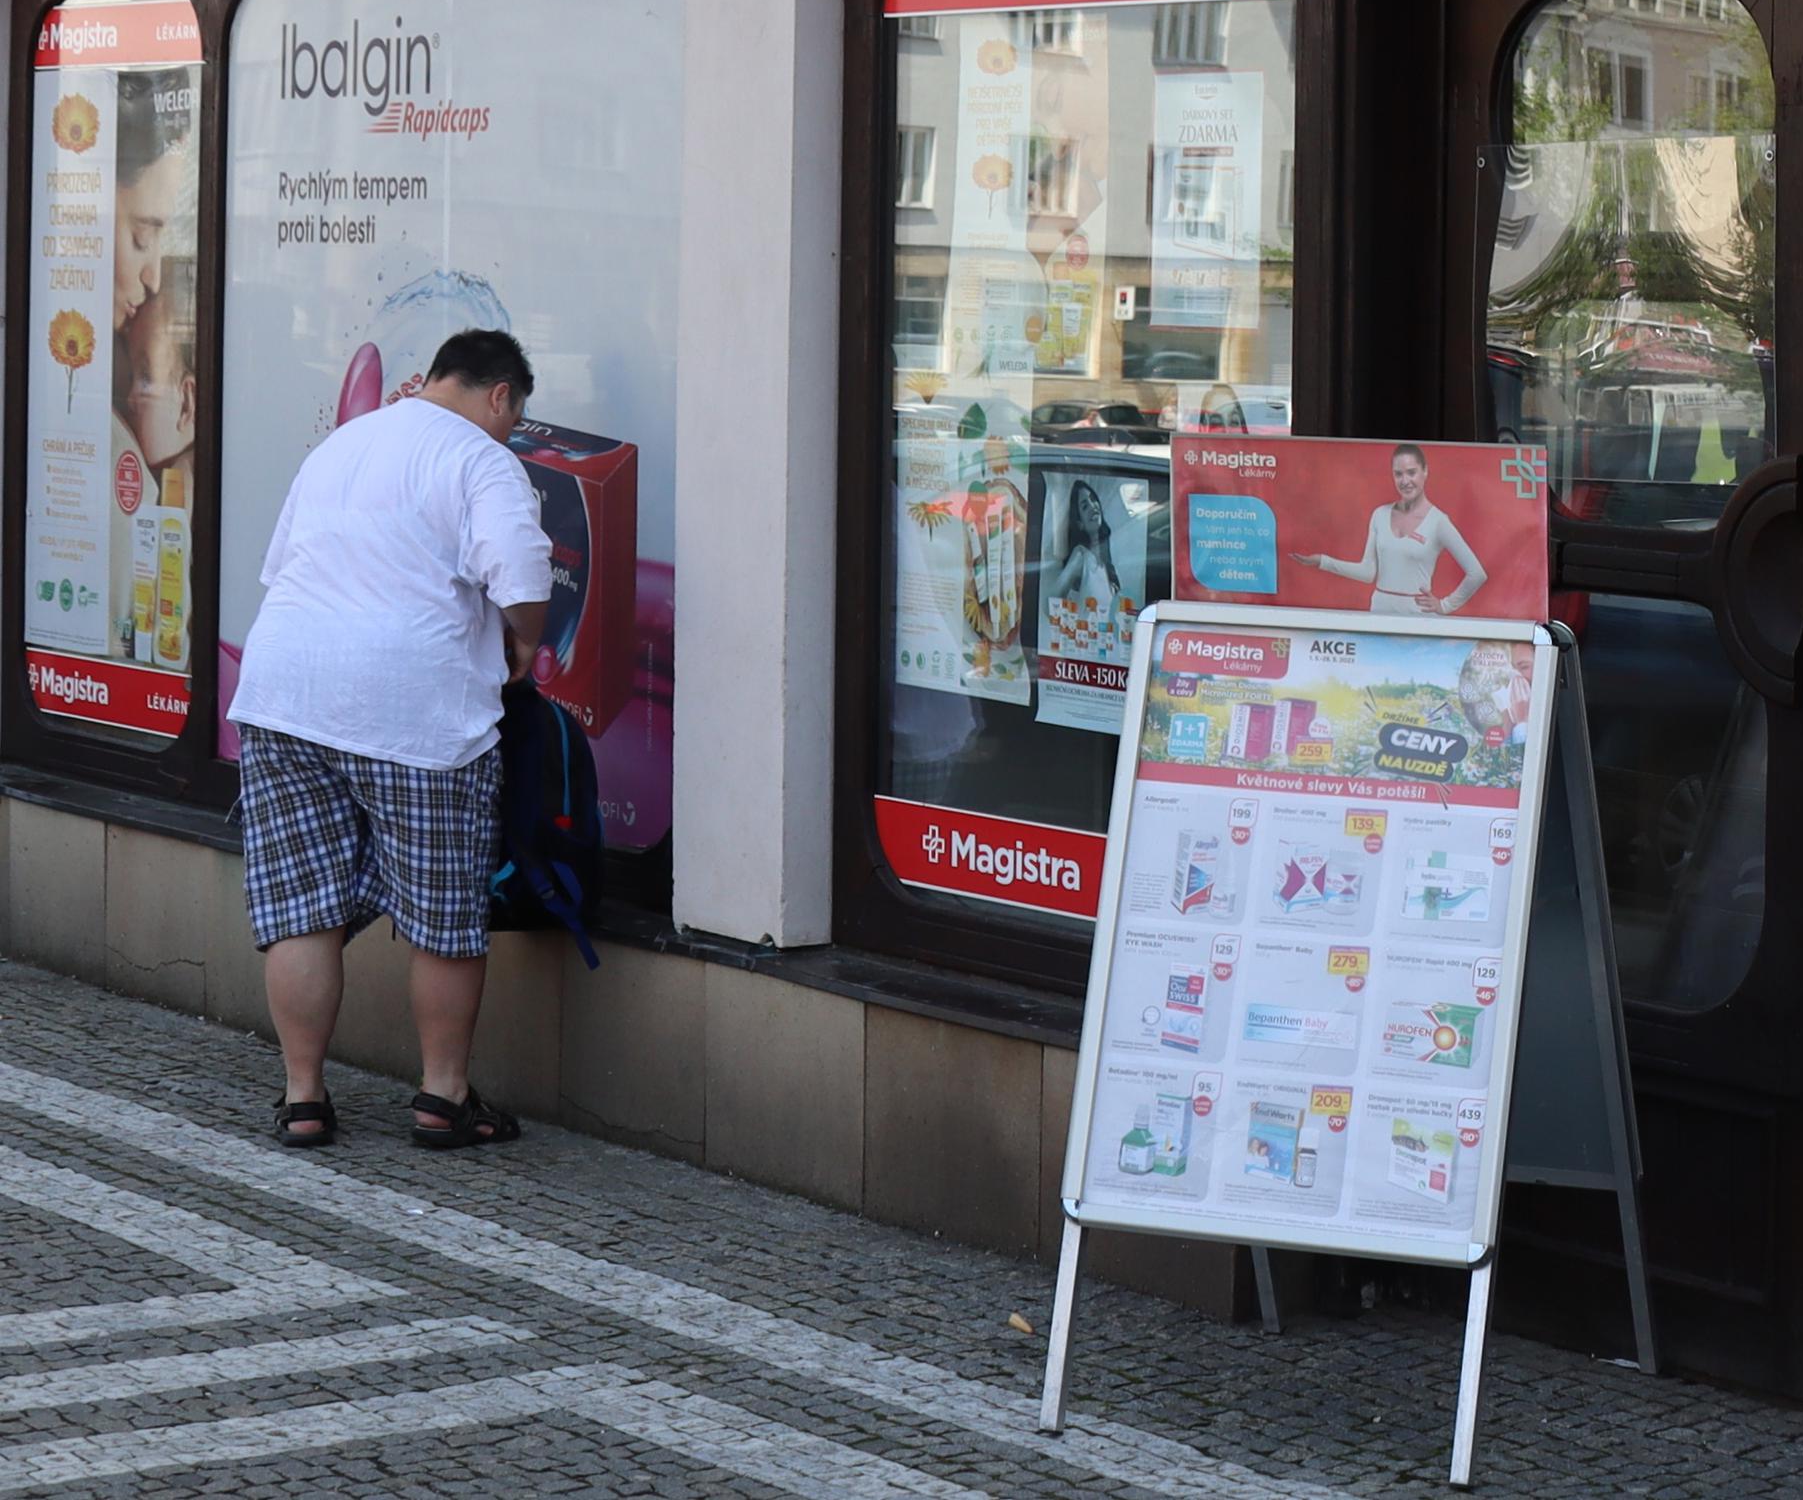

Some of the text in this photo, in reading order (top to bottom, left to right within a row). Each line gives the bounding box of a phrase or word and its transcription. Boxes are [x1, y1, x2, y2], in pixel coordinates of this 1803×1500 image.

[49, 20, 118, 55] Magistra
[155, 21, 198, 42] LÉKÁRN
[401, 99, 491, 142] Rapidcaps
[277, 168, 428, 207] Rychlým tempem
[277, 214, 376, 249] proti bolesti
[1201, 450, 1277, 469] Magistra
[1238, 467, 1277, 480] Lékárny
[1196, 507, 1257, 521] Doporučím
[1186, 638, 1264, 661] Magistra
[1309, 639, 1358, 656] AKCE
[1054, 660, 1091, 684] SLEVA
[1092, 667, 1117, 687] -150
[1223, 660, 1263, 674] Lékárny
[40, 665, 109, 706] Magistra
[146, 691, 190, 717] LÉKÁRN
[1174, 719, 1207, 736] 1+1
[1390, 727, 1458, 756] CENY
[1378, 753, 1450, 778] NA UZDĚ
[1236, 771, 1427, 802] Květnové slevy Vás potěší!
[950, 830, 1081, 892] Magistra
